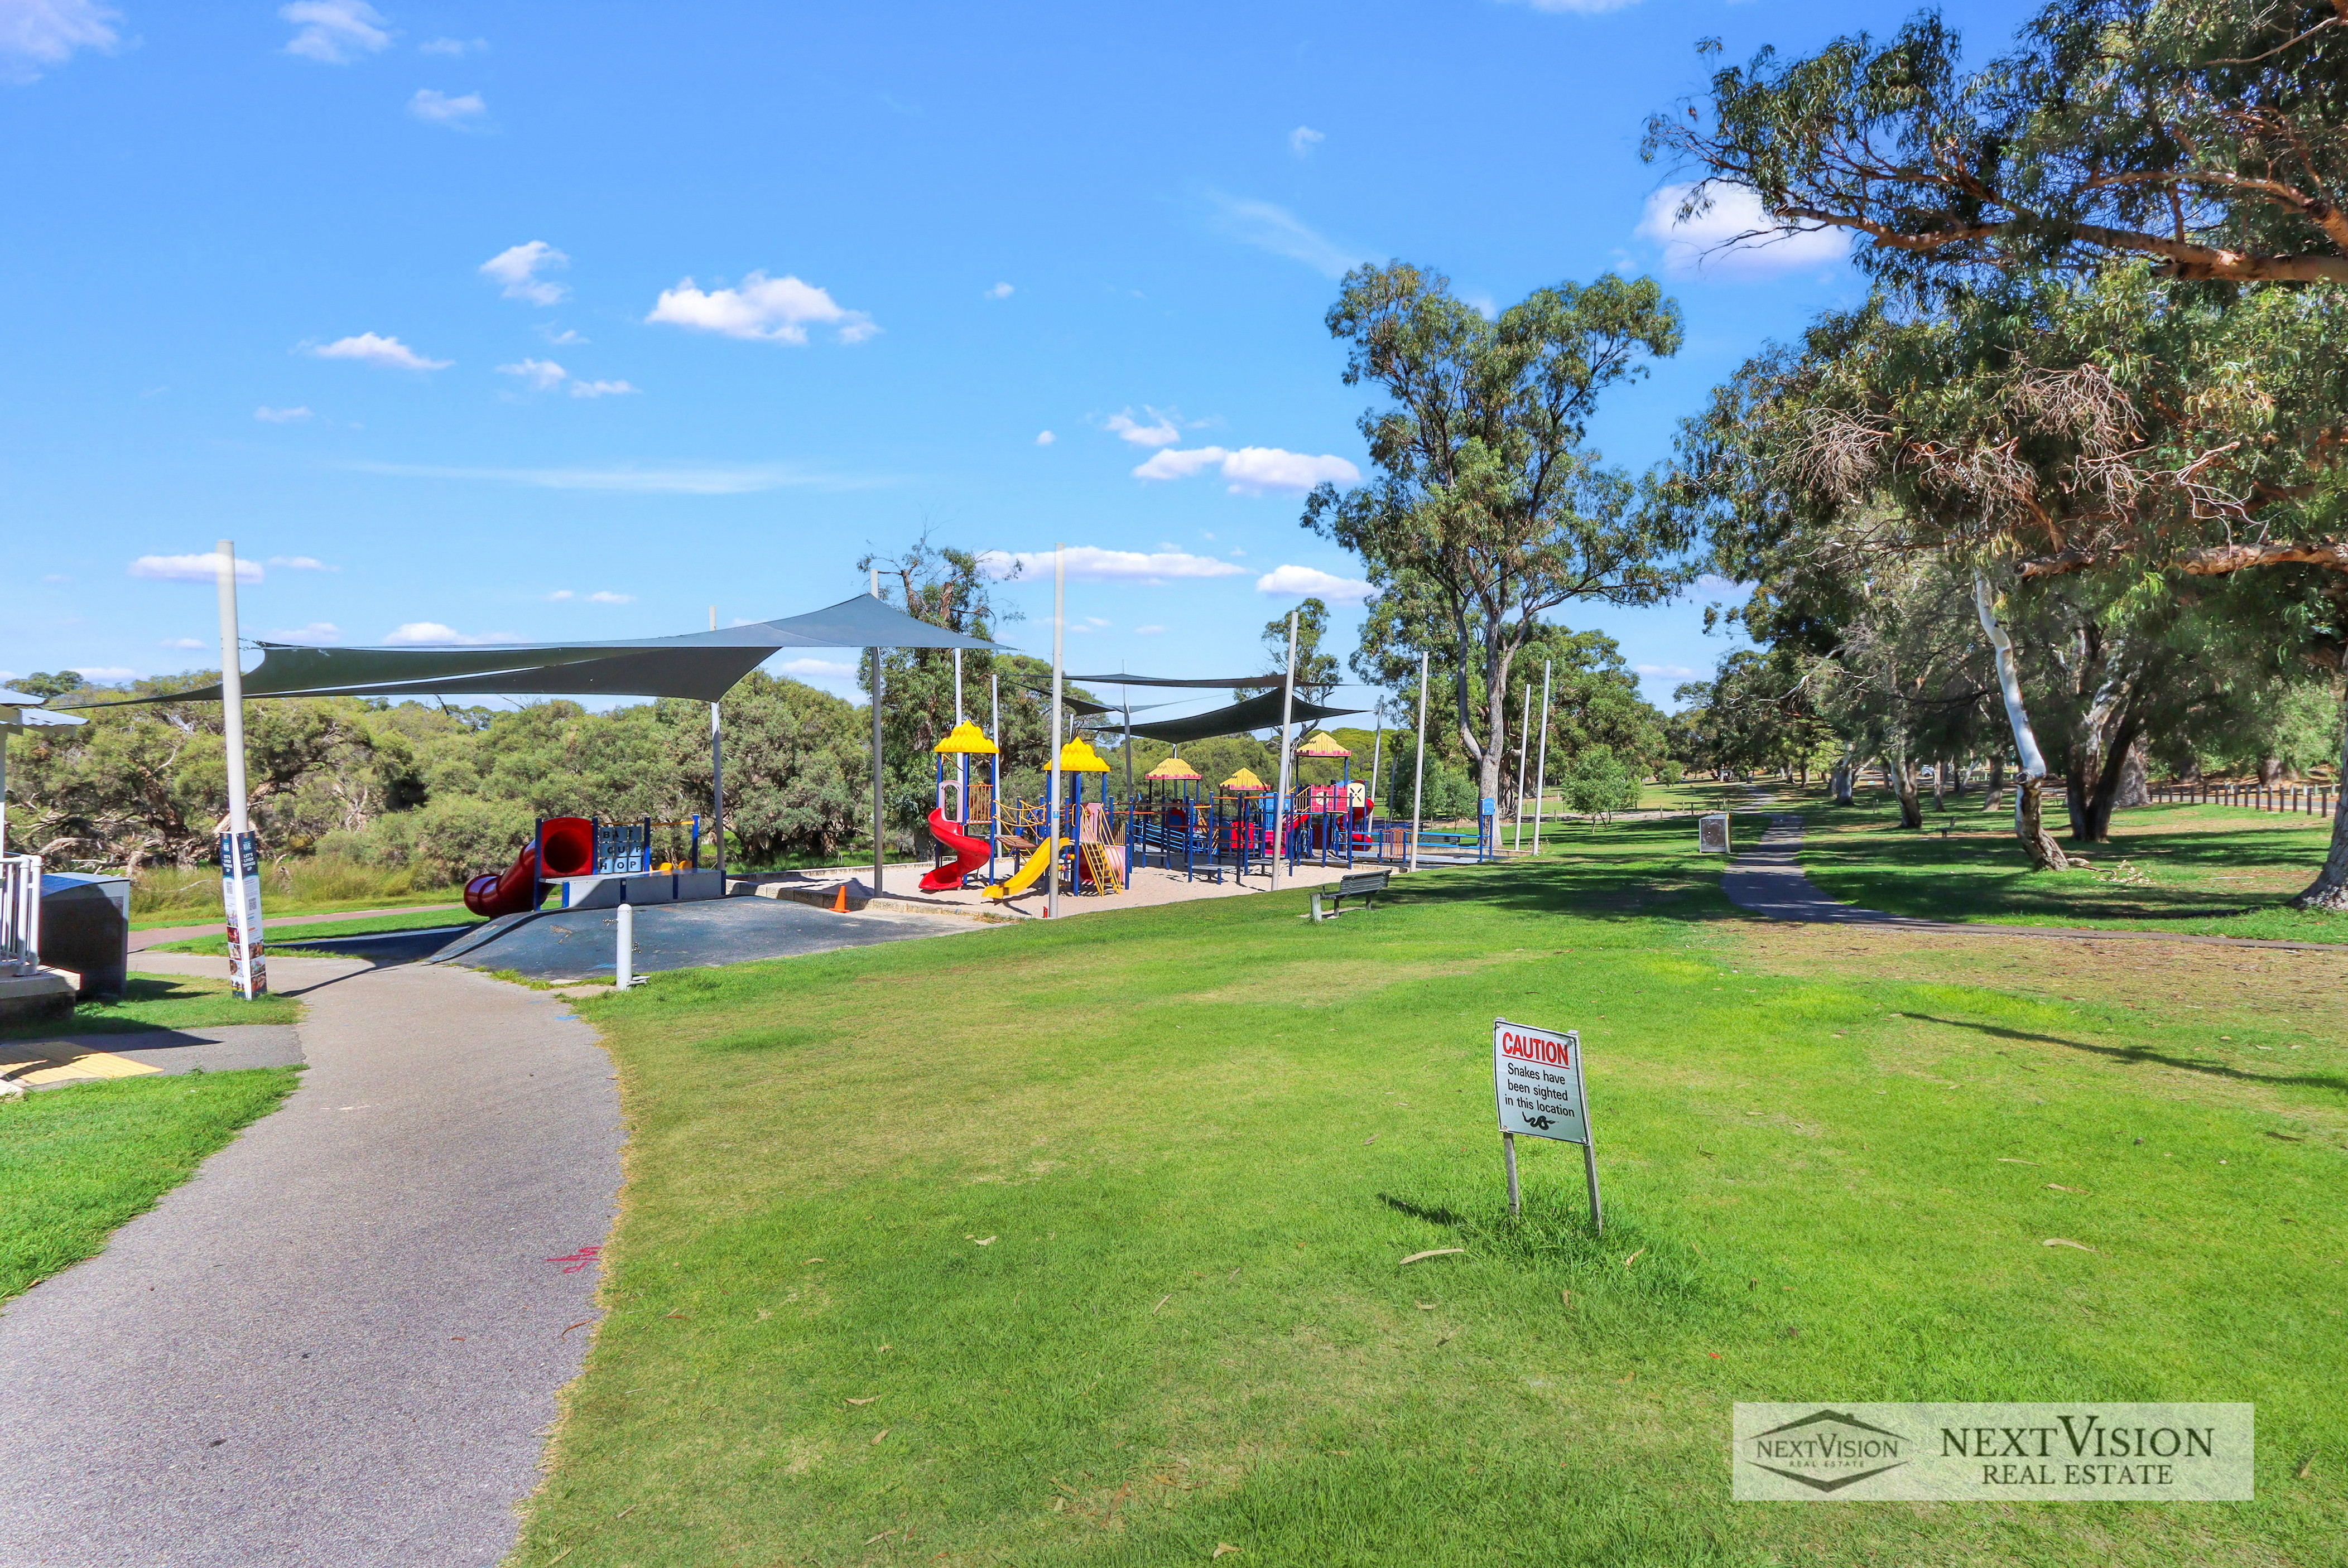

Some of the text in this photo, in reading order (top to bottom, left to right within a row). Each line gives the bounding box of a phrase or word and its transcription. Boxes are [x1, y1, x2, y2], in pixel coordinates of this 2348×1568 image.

[607, 846, 641, 854] CUP
[600, 861, 636, 870] HOP
[1503, 1032, 1568, 1066] CAUTION
[1508, 1063, 1565, 1085] Snakes have
[1508, 1079, 1568, 1101] been sighted
[1505, 1094, 1575, 1117] in this location
